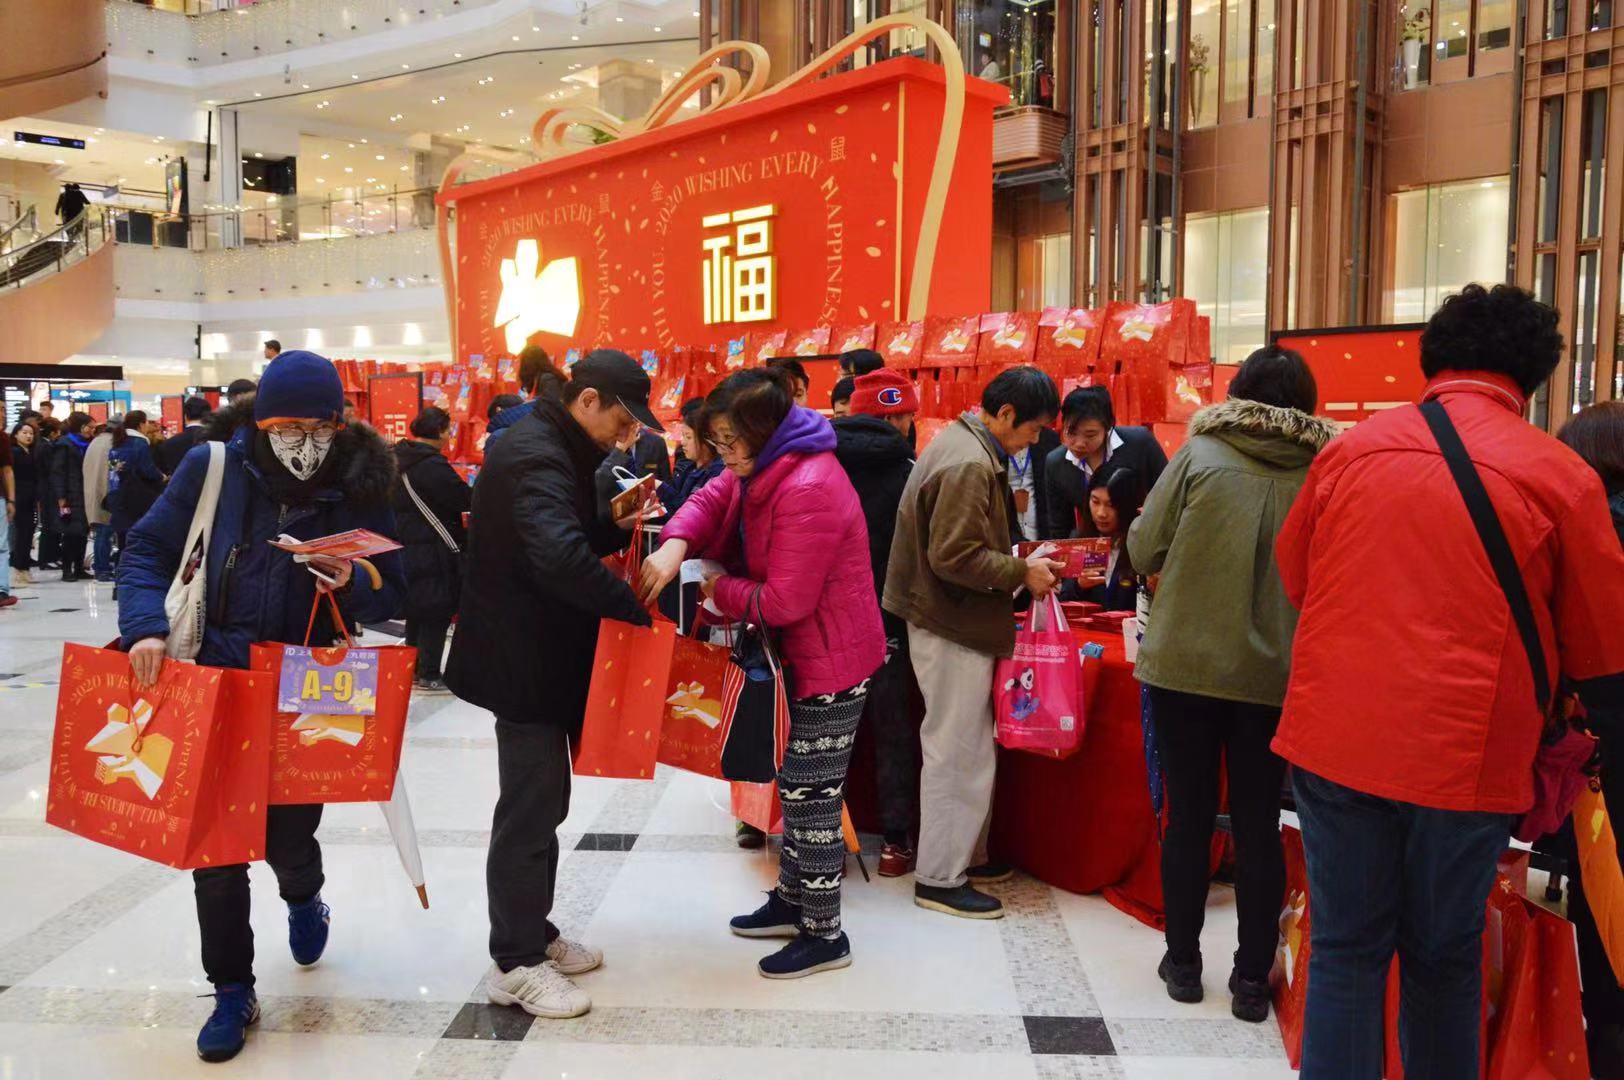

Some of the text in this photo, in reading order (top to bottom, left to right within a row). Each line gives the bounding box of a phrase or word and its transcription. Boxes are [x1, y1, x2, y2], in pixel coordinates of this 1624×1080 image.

[656, 184, 683, 237] 2020
[685, 161, 753, 196] WISHING
[760, 151, 824, 179] EVERY
[503, 211, 550, 237] WISHING
[554, 203, 592, 226] EVERY
[703, 203, 777, 325] 福
[70, 674, 101, 706] 2020
[301, 670, 353, 702] A-9
